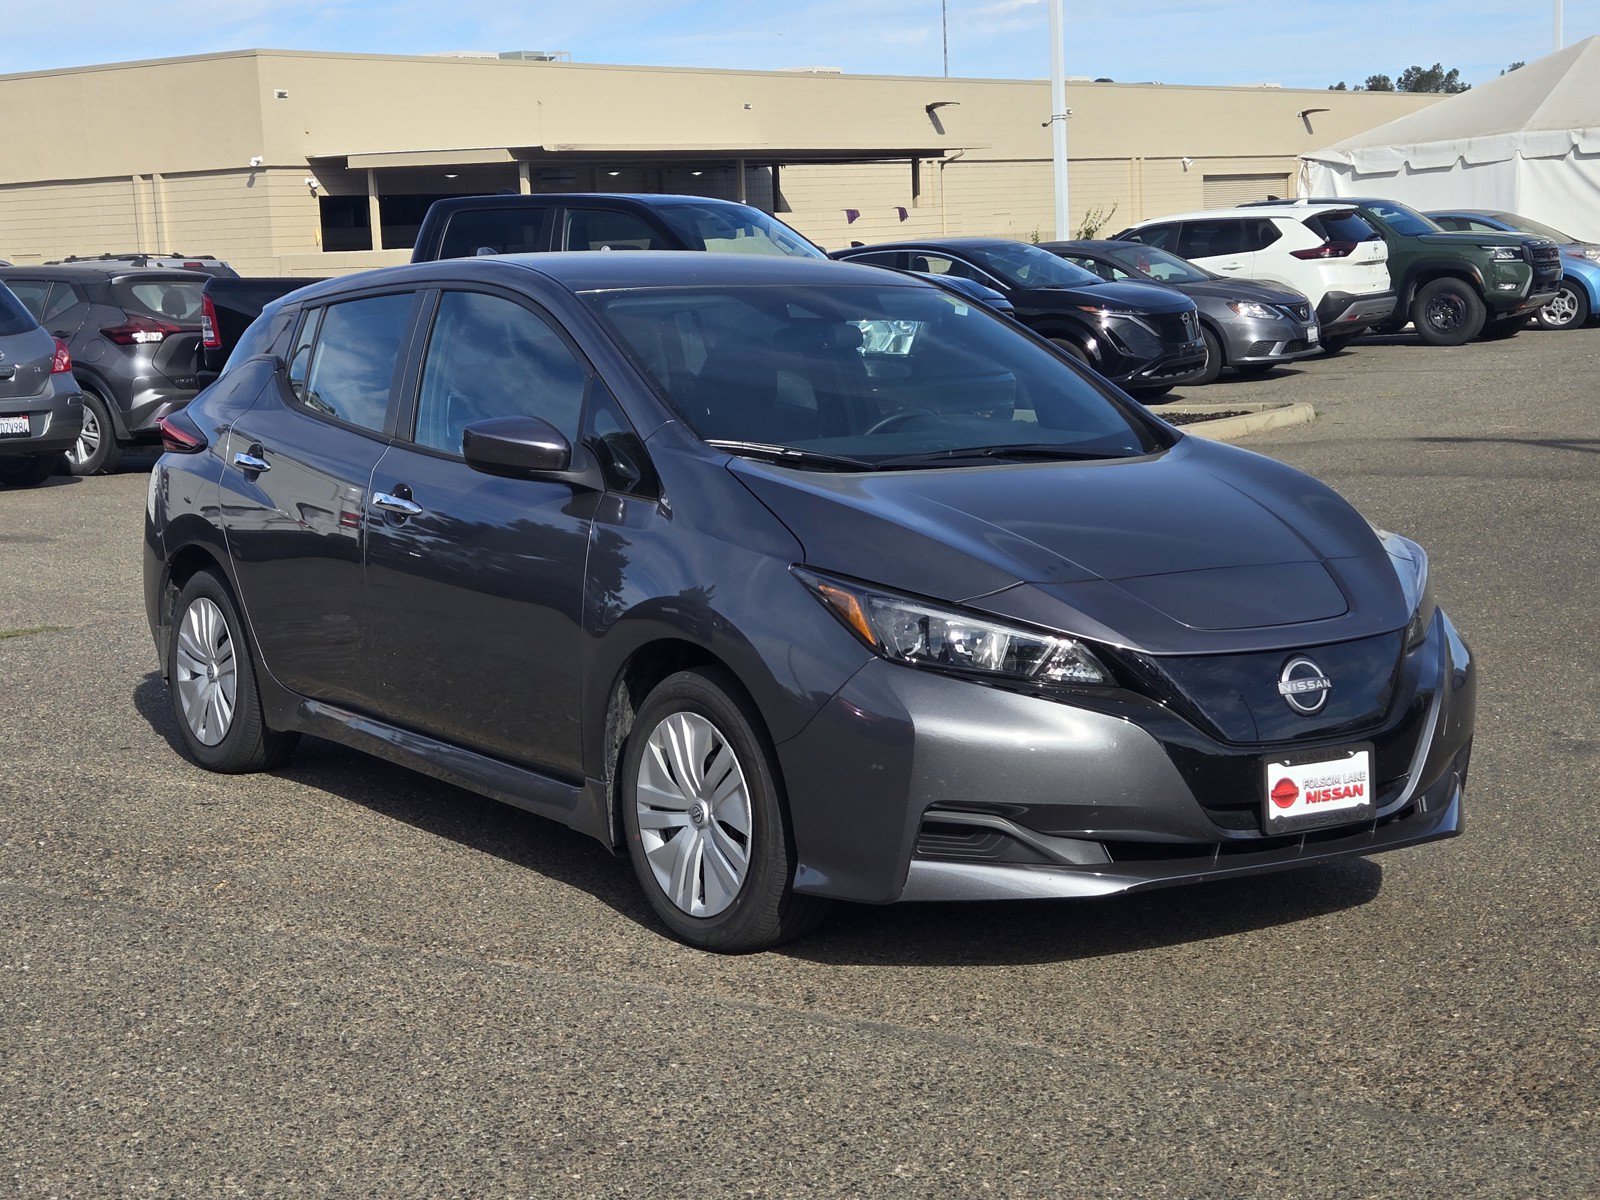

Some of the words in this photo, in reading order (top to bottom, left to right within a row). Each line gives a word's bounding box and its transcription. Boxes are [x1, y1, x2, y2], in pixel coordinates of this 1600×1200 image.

[1279, 678, 1332, 692] NISSAN
[1303, 775, 1341, 790] FOLSOM
[1343, 770, 1367, 785] LAKE
[1305, 783, 1364, 805] NISSAN
